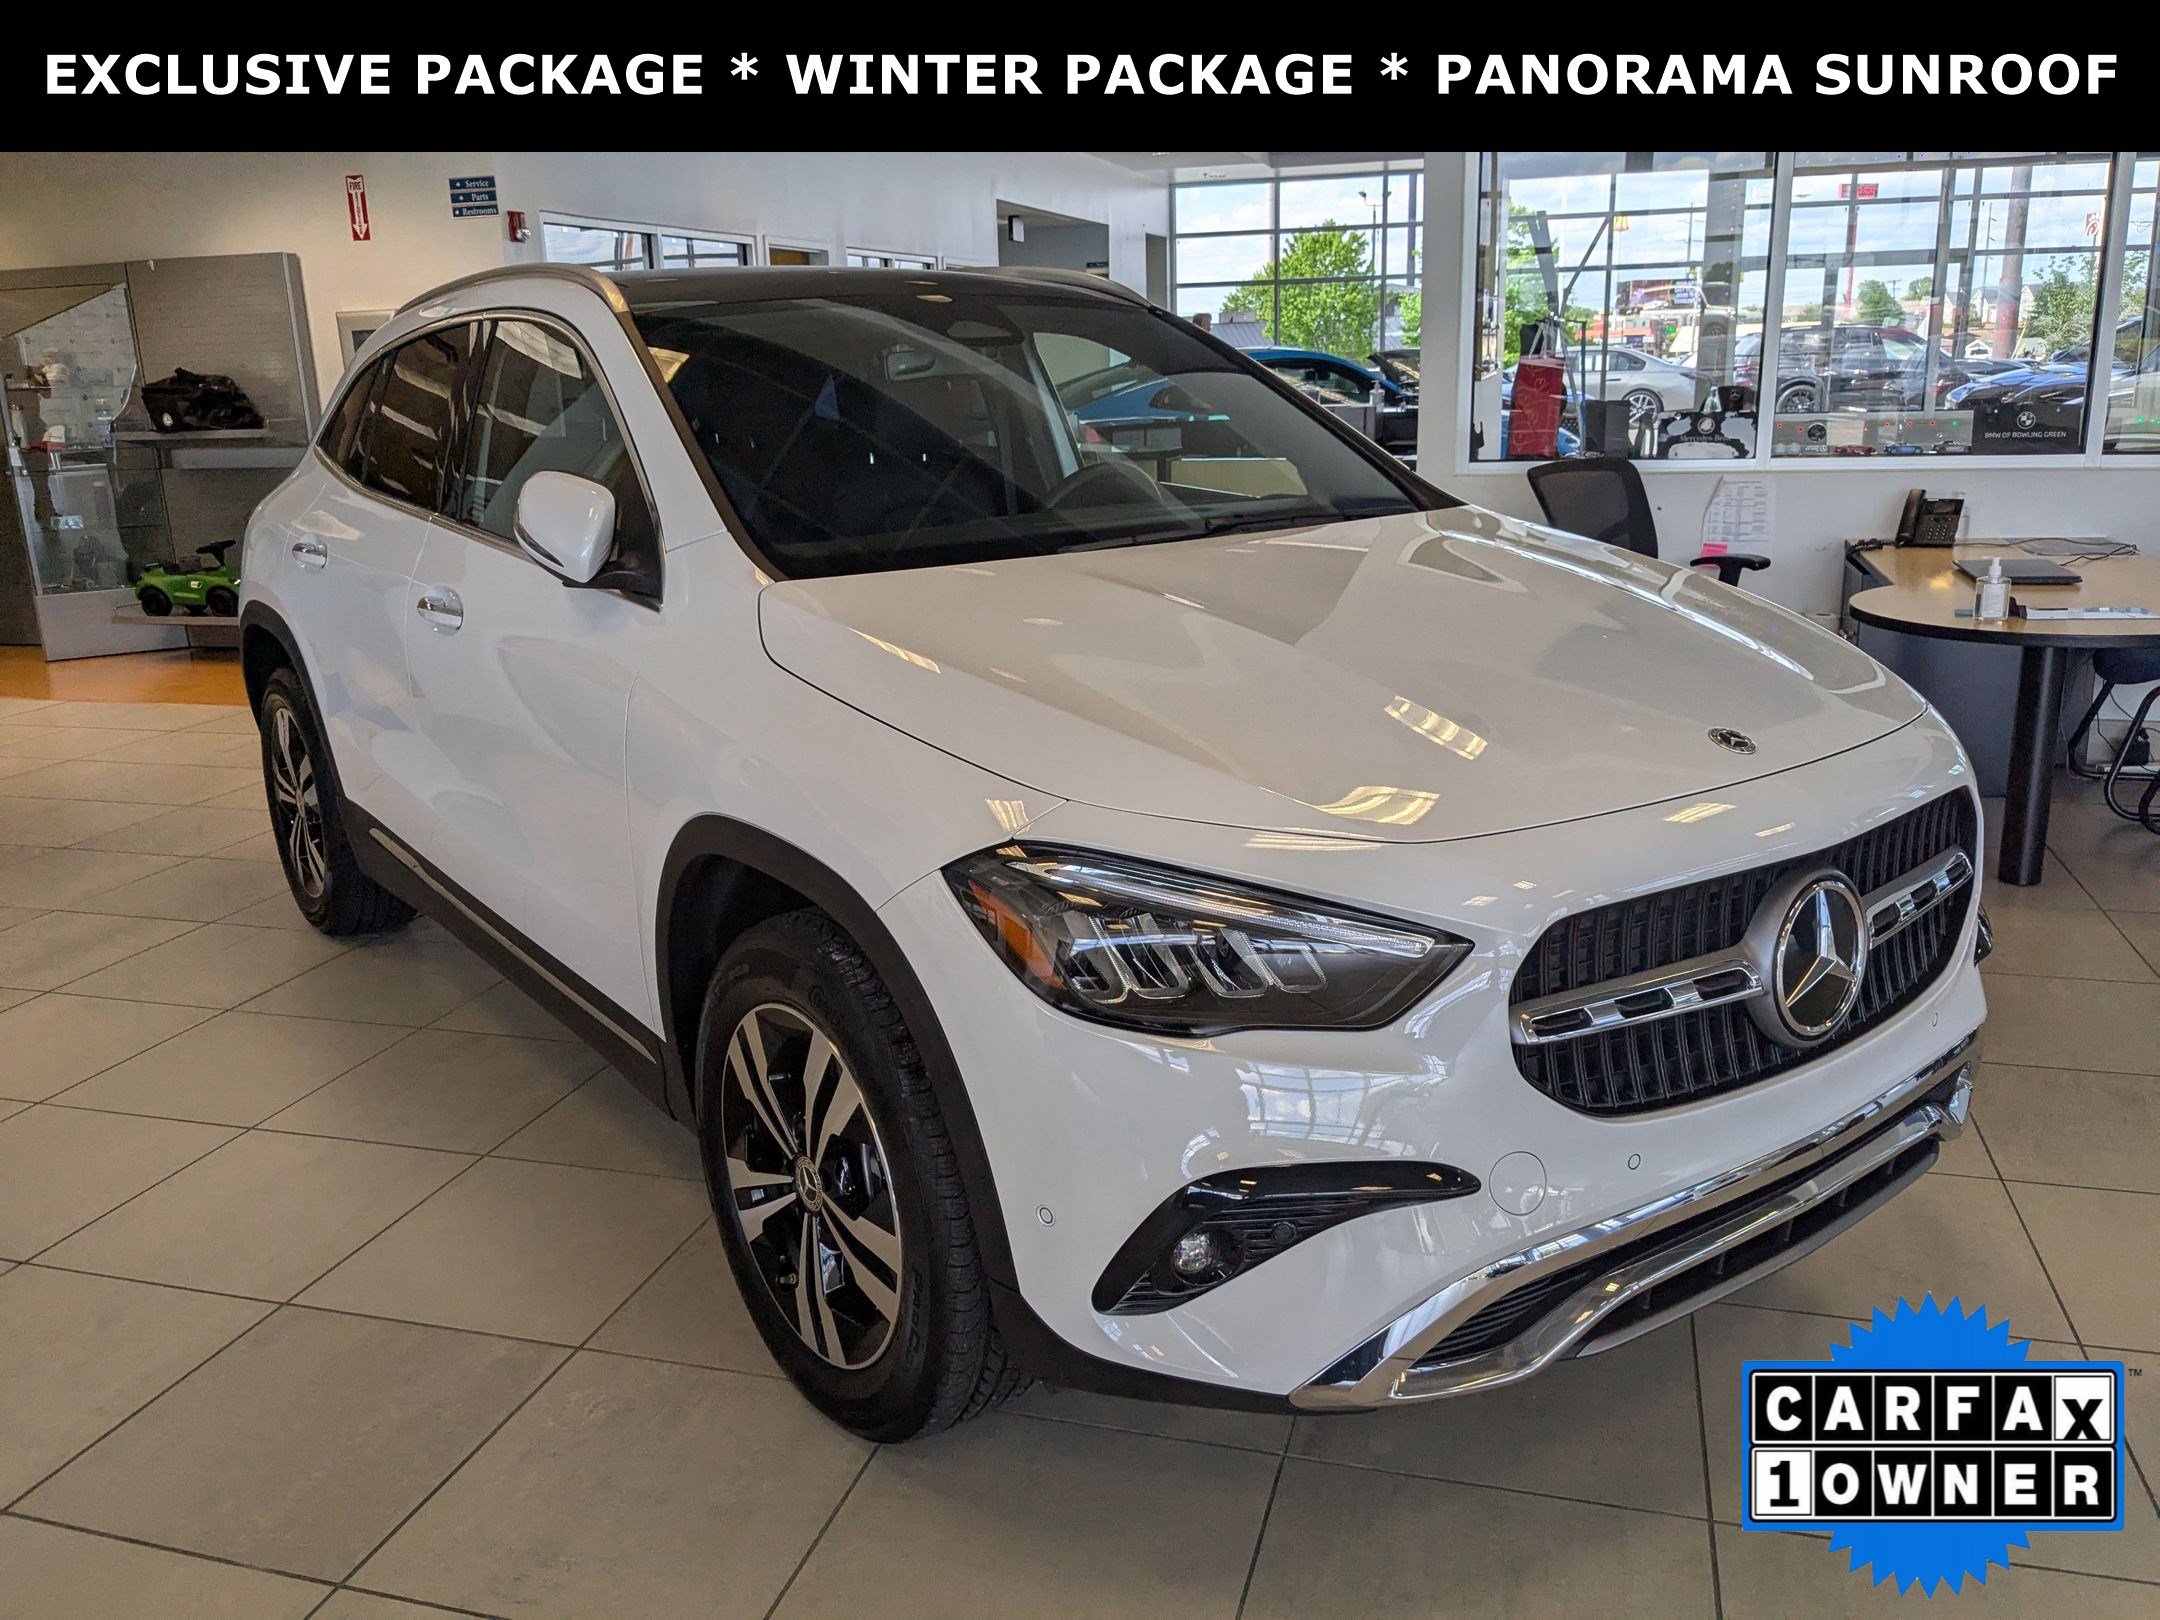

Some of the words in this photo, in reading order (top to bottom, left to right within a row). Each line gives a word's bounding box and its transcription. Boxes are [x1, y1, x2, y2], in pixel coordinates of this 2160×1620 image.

[349, 181, 362, 190] FIRE
[465, 179, 489, 187] Service
[471, 193, 489, 201] Parts
[462, 207, 497, 216] Restrooms
[1984, 431, 2001, 439] BMW
[2002, 431, 2011, 439] OF
